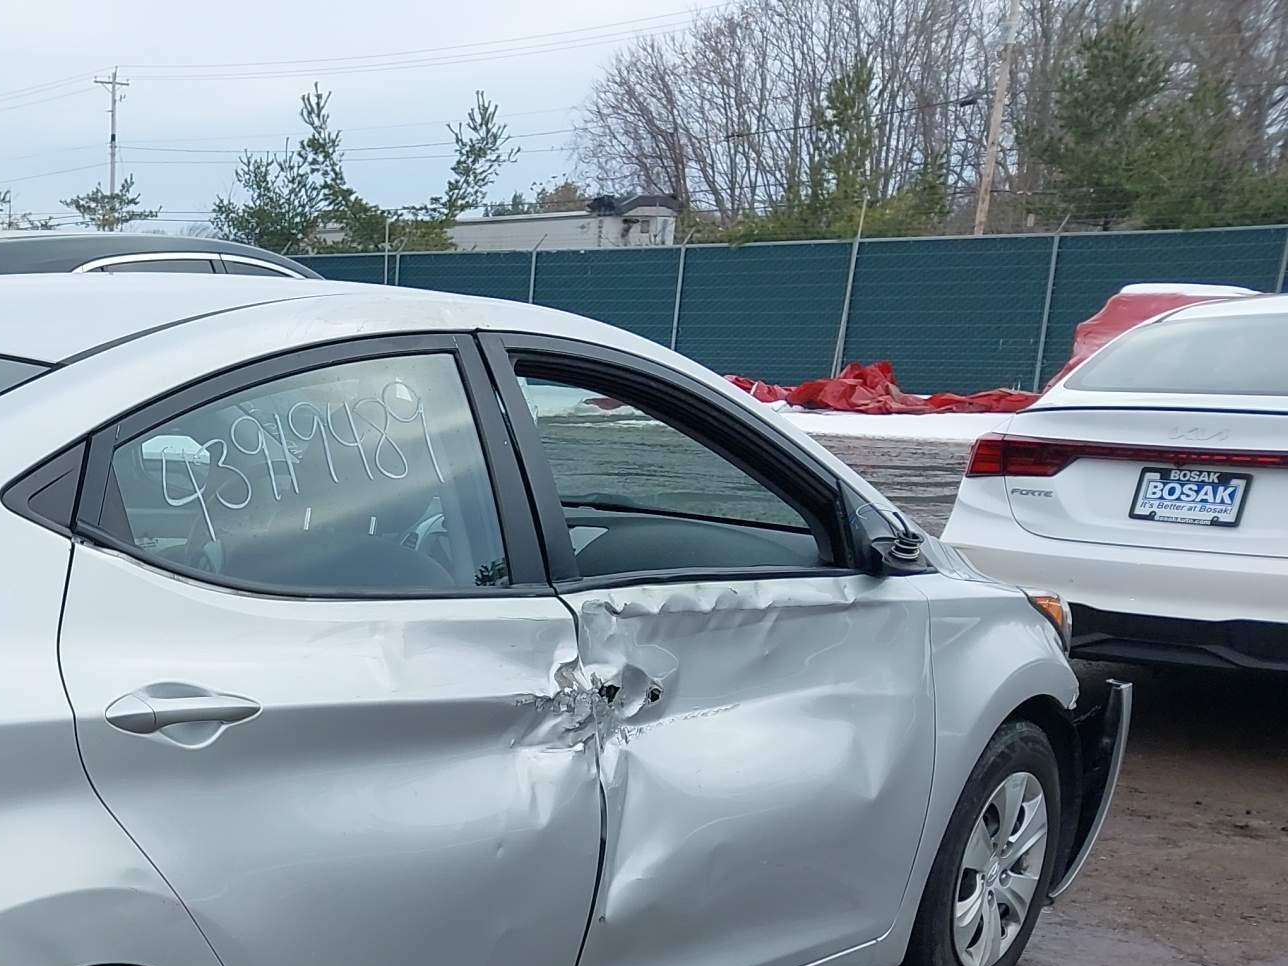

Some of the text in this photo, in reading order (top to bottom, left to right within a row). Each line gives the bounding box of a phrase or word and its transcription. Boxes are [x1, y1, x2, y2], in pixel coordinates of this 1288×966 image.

[161, 382, 446, 542] 43919489
[1170, 470, 1220, 483] BOSAK
[1012, 488, 1054, 497] FORTE
[1146, 481, 1235, 504] BOSAK
[1156, 502, 1186, 511] Better
[1198, 505, 1233, 515] Bosak!
